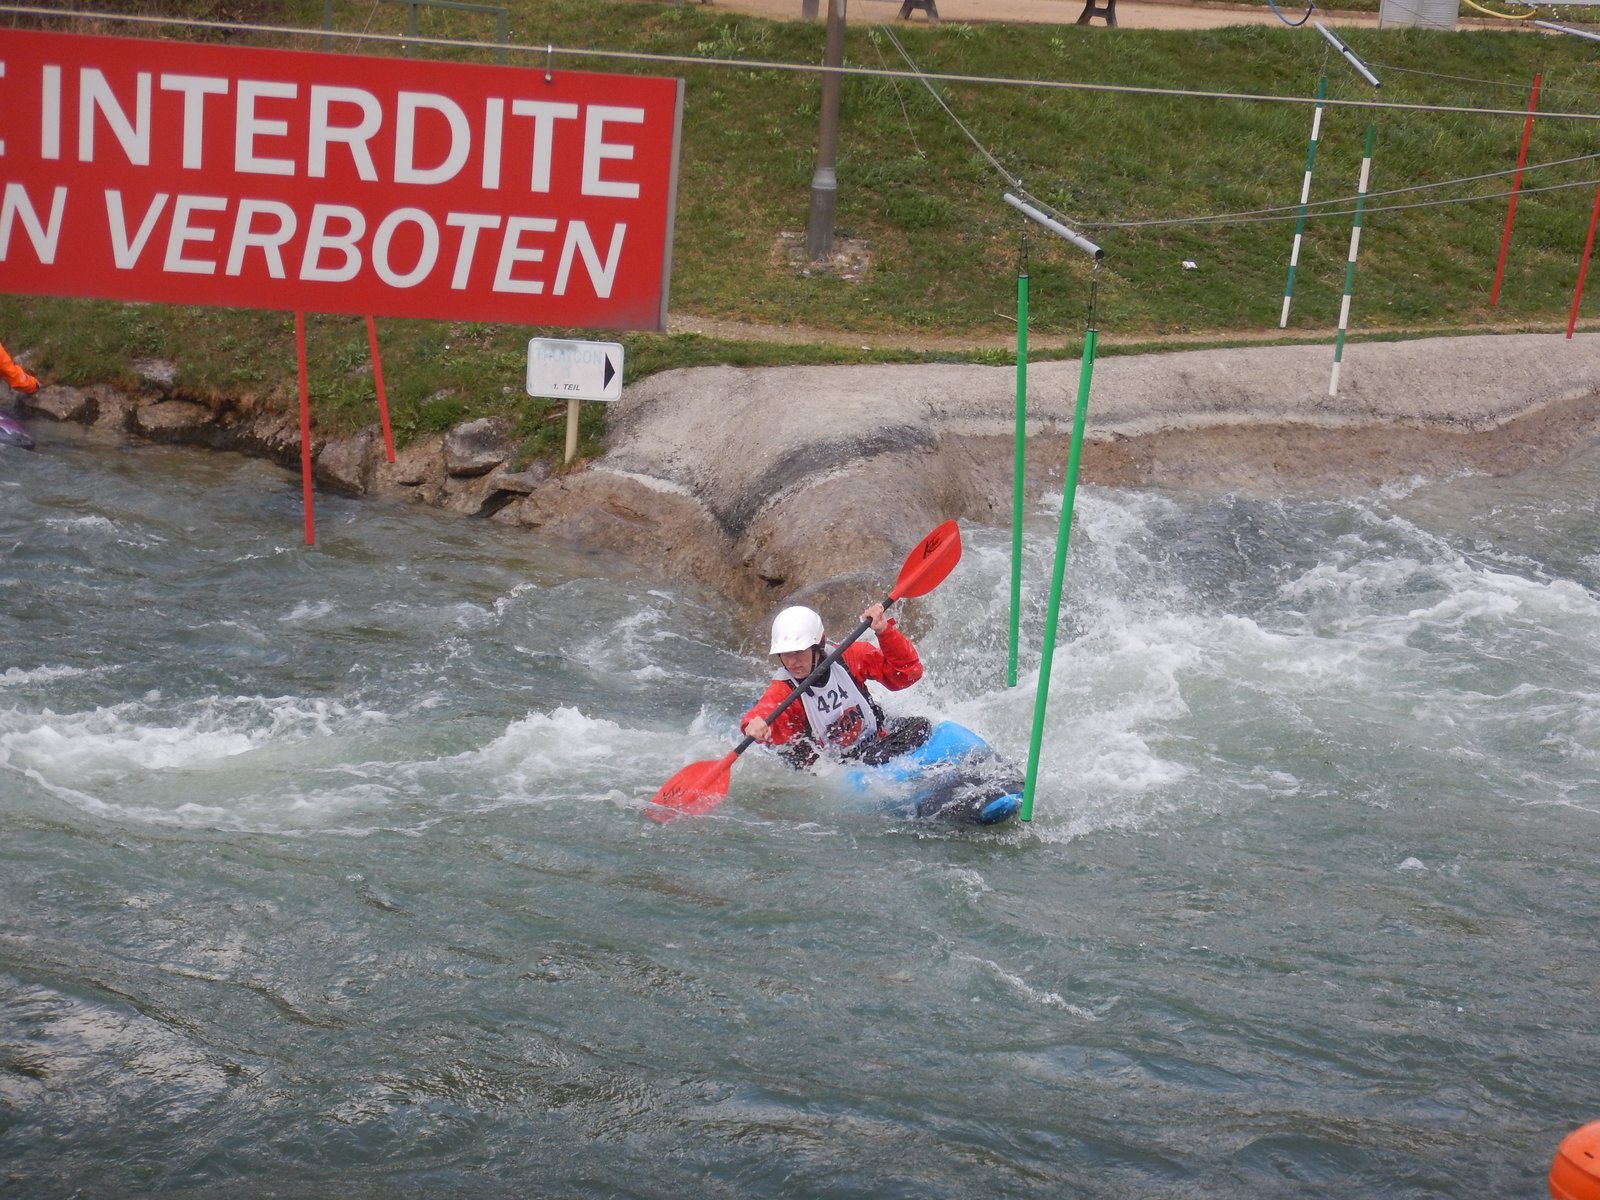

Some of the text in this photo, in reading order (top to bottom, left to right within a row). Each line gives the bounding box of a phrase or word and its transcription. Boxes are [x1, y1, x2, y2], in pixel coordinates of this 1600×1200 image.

[41, 64, 645, 199] INTERDITE
[105, 189, 627, 299] VERBOTEN
[563, 383, 581, 391] TEIL
[817, 683, 849, 714] 424
